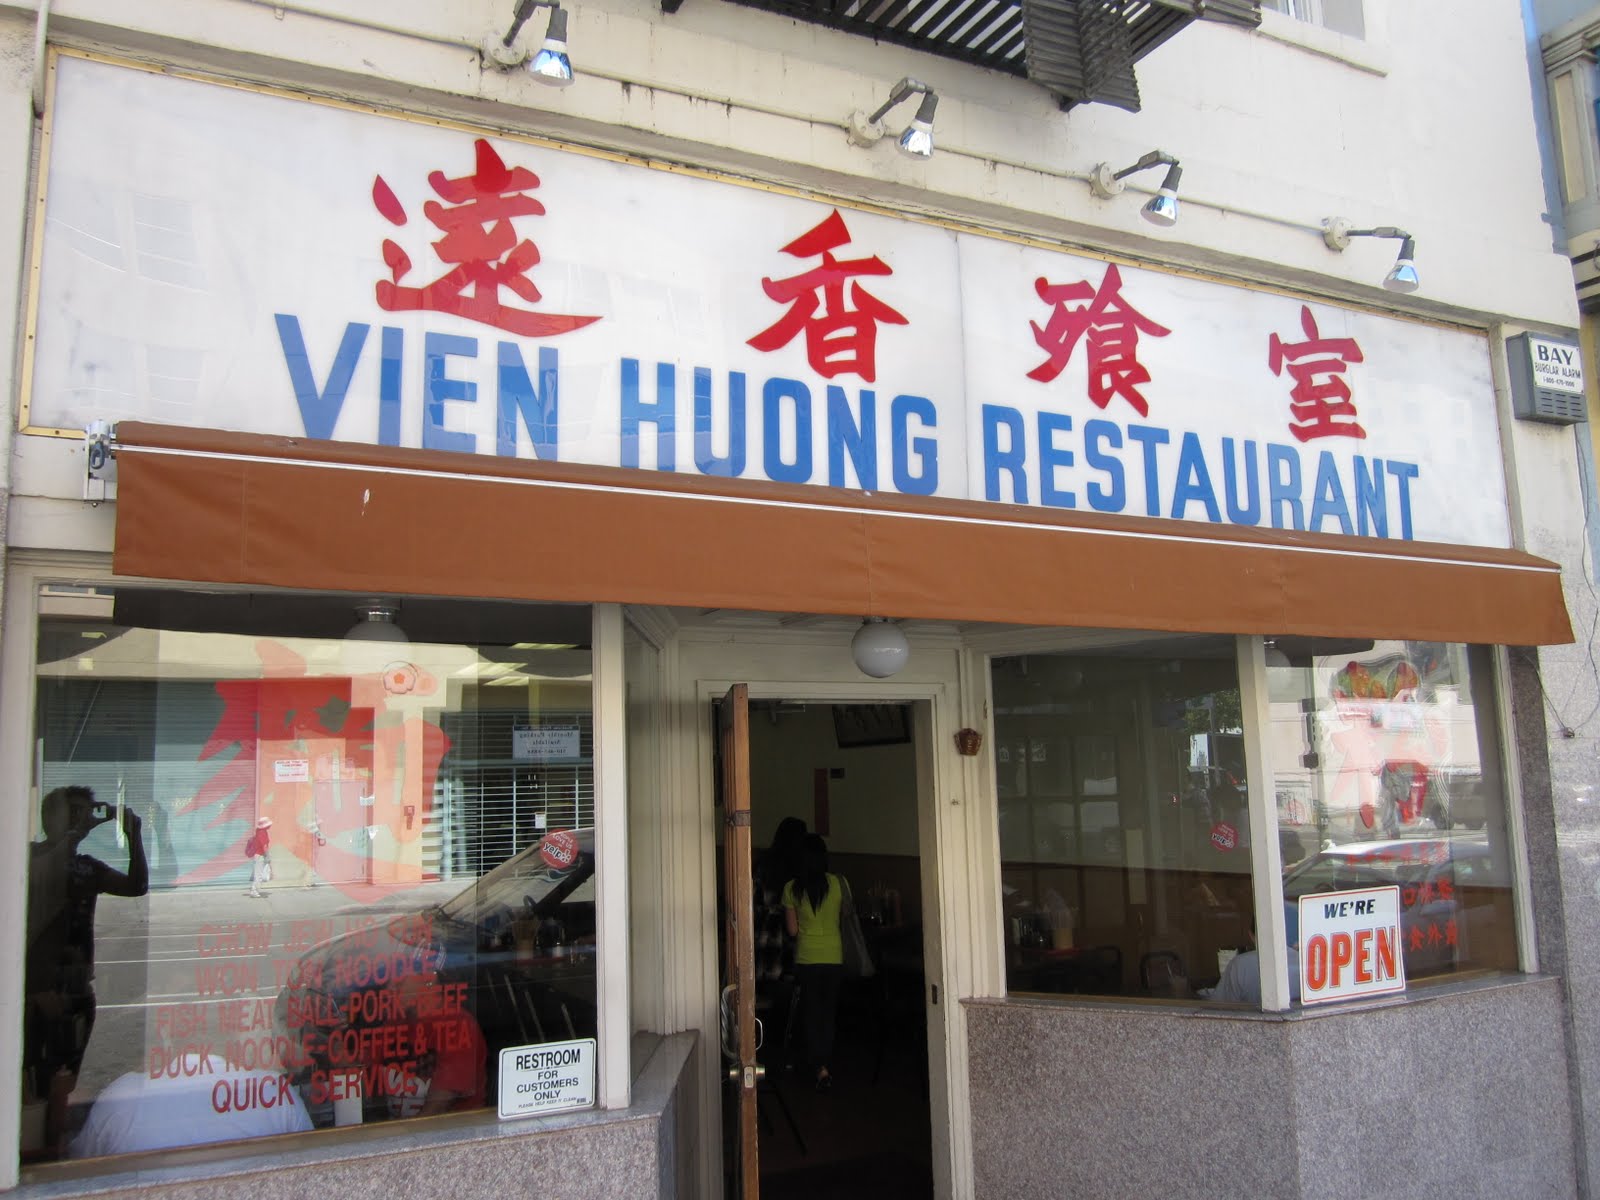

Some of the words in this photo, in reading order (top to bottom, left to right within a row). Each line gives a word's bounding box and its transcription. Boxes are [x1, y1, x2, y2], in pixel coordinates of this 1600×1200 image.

[1537, 344, 1574, 366] BAY
[1534, 362, 1560, 375] BURGLAR
[1561, 367, 1581, 379] ALARM
[274, 313, 559, 461] VIEN
[620, 357, 938, 496] HUONG
[981, 403, 1419, 541] RESTAURANT
[543, 842, 563, 859] yelp
[1323, 898, 1376, 920] WE'RE
[1306, 925, 1397, 991] OPEN
[194, 961, 258, 997] WON
[272, 957, 323, 991] TON
[335, 949, 438, 988] NOODLE
[155, 1003, 207, 1041] FISH
[218, 998, 273, 1034] MEAT
[150, 1045, 214, 1080] DUCK
[414, 1023, 428, 1051] &
[431, 1020, 472, 1050] TEA
[516, 1048, 581, 1071] RESTROOM
[516, 1077, 579, 1094] CUSTOMERS
[537, 1070, 558, 1080] FOR
[211, 1074, 295, 1114] QUICK
[310, 1061, 418, 1106] SERVICE
[533, 1089, 561, 1101] ONLY
